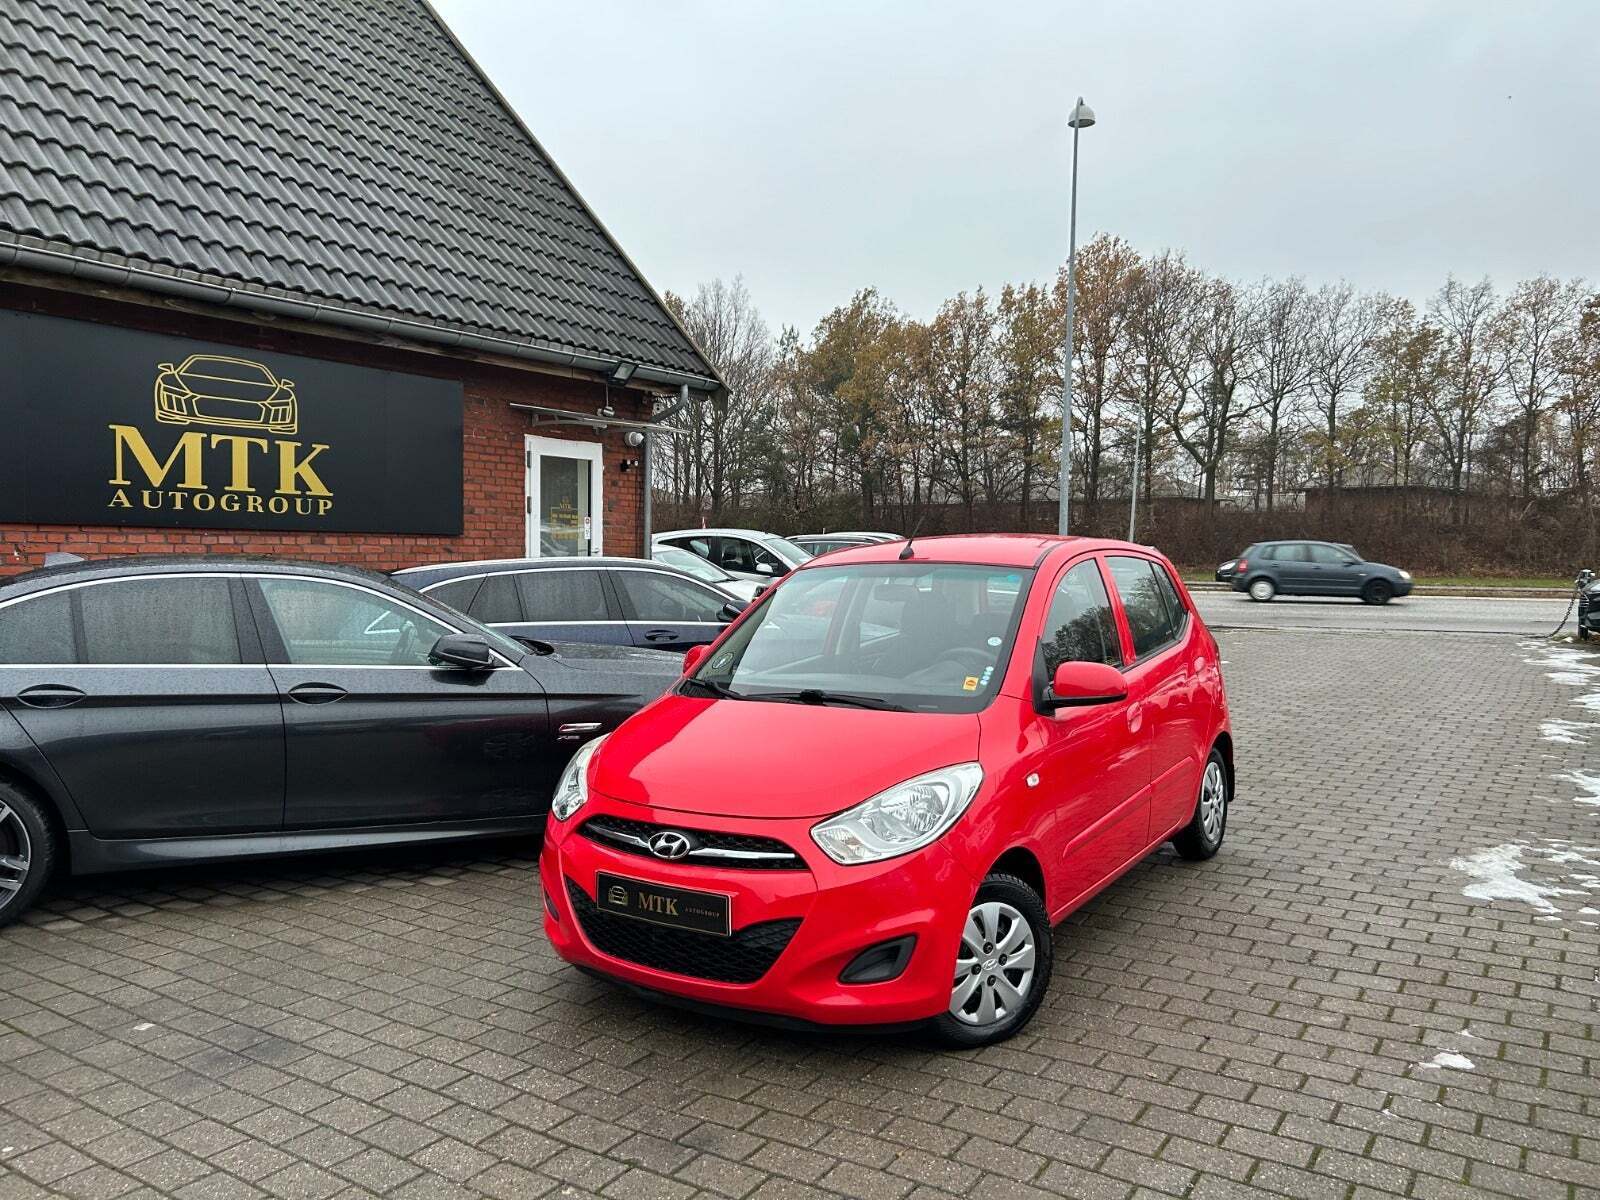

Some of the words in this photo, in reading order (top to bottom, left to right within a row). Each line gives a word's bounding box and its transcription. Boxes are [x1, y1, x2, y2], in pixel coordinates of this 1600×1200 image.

[108, 424, 334, 497] MTK
[107, 488, 334, 516] AUTOGROUP
[638, 892, 679, 916] MTK
